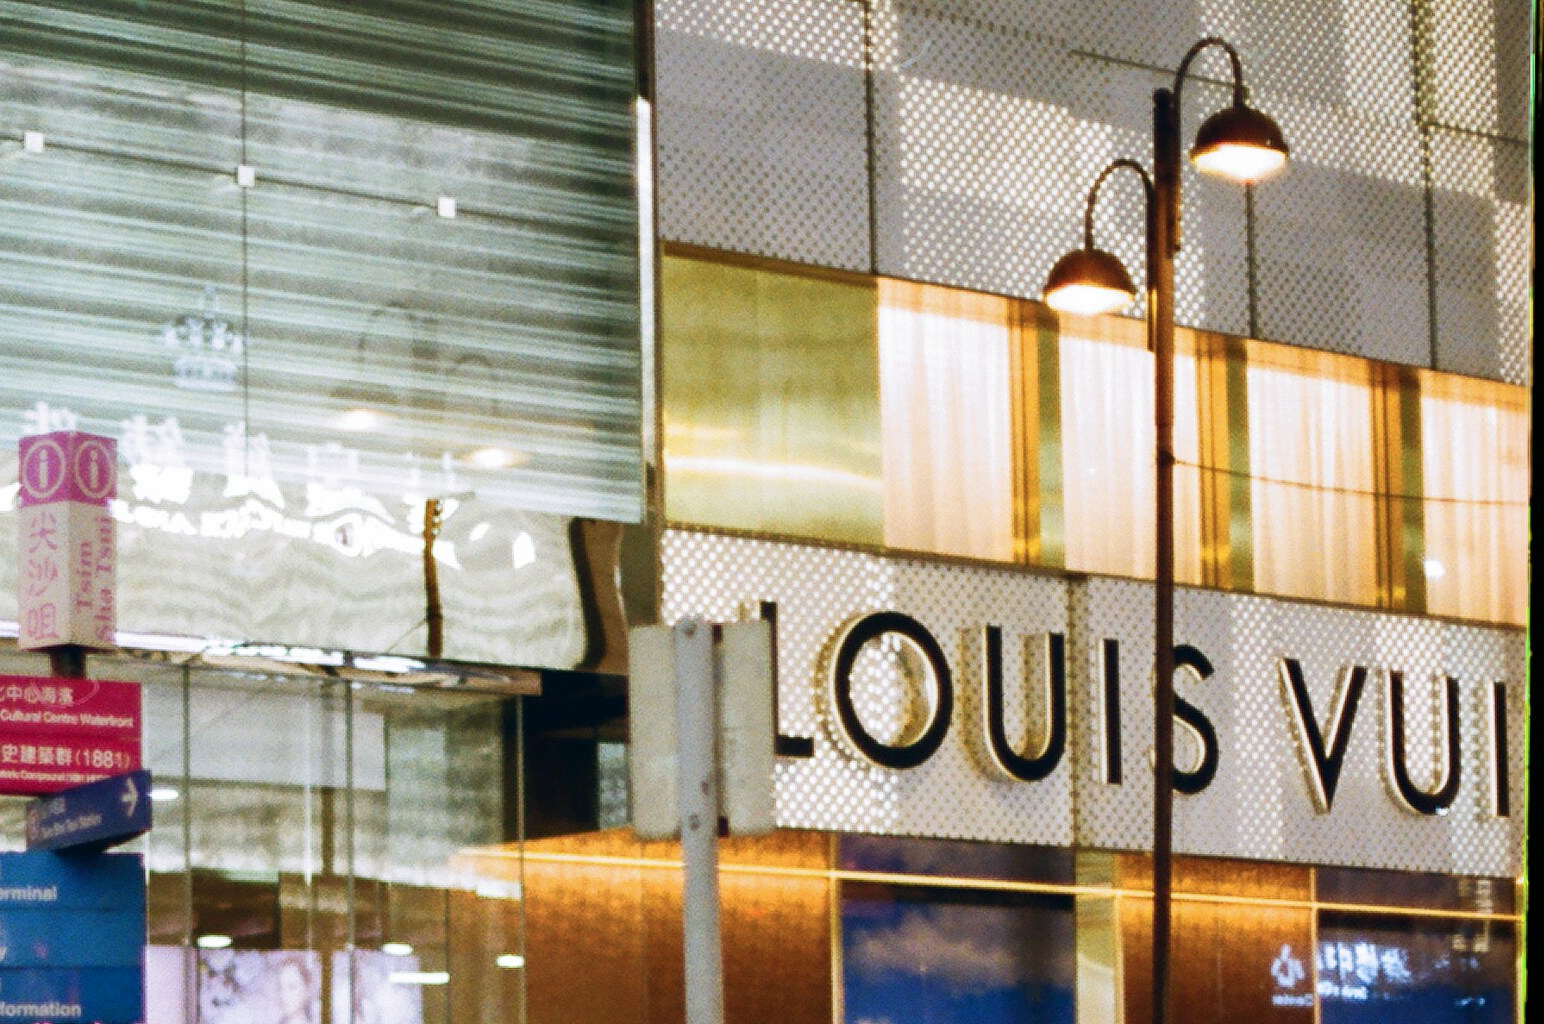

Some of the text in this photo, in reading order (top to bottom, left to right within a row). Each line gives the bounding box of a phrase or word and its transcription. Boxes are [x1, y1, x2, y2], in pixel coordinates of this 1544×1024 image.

[78, 541, 93, 616] Tsim
[0, 708, 41, 721] Cultural
[80, 713, 134, 728] Waterfront
[761, 601, 1218, 795] LOUIS
